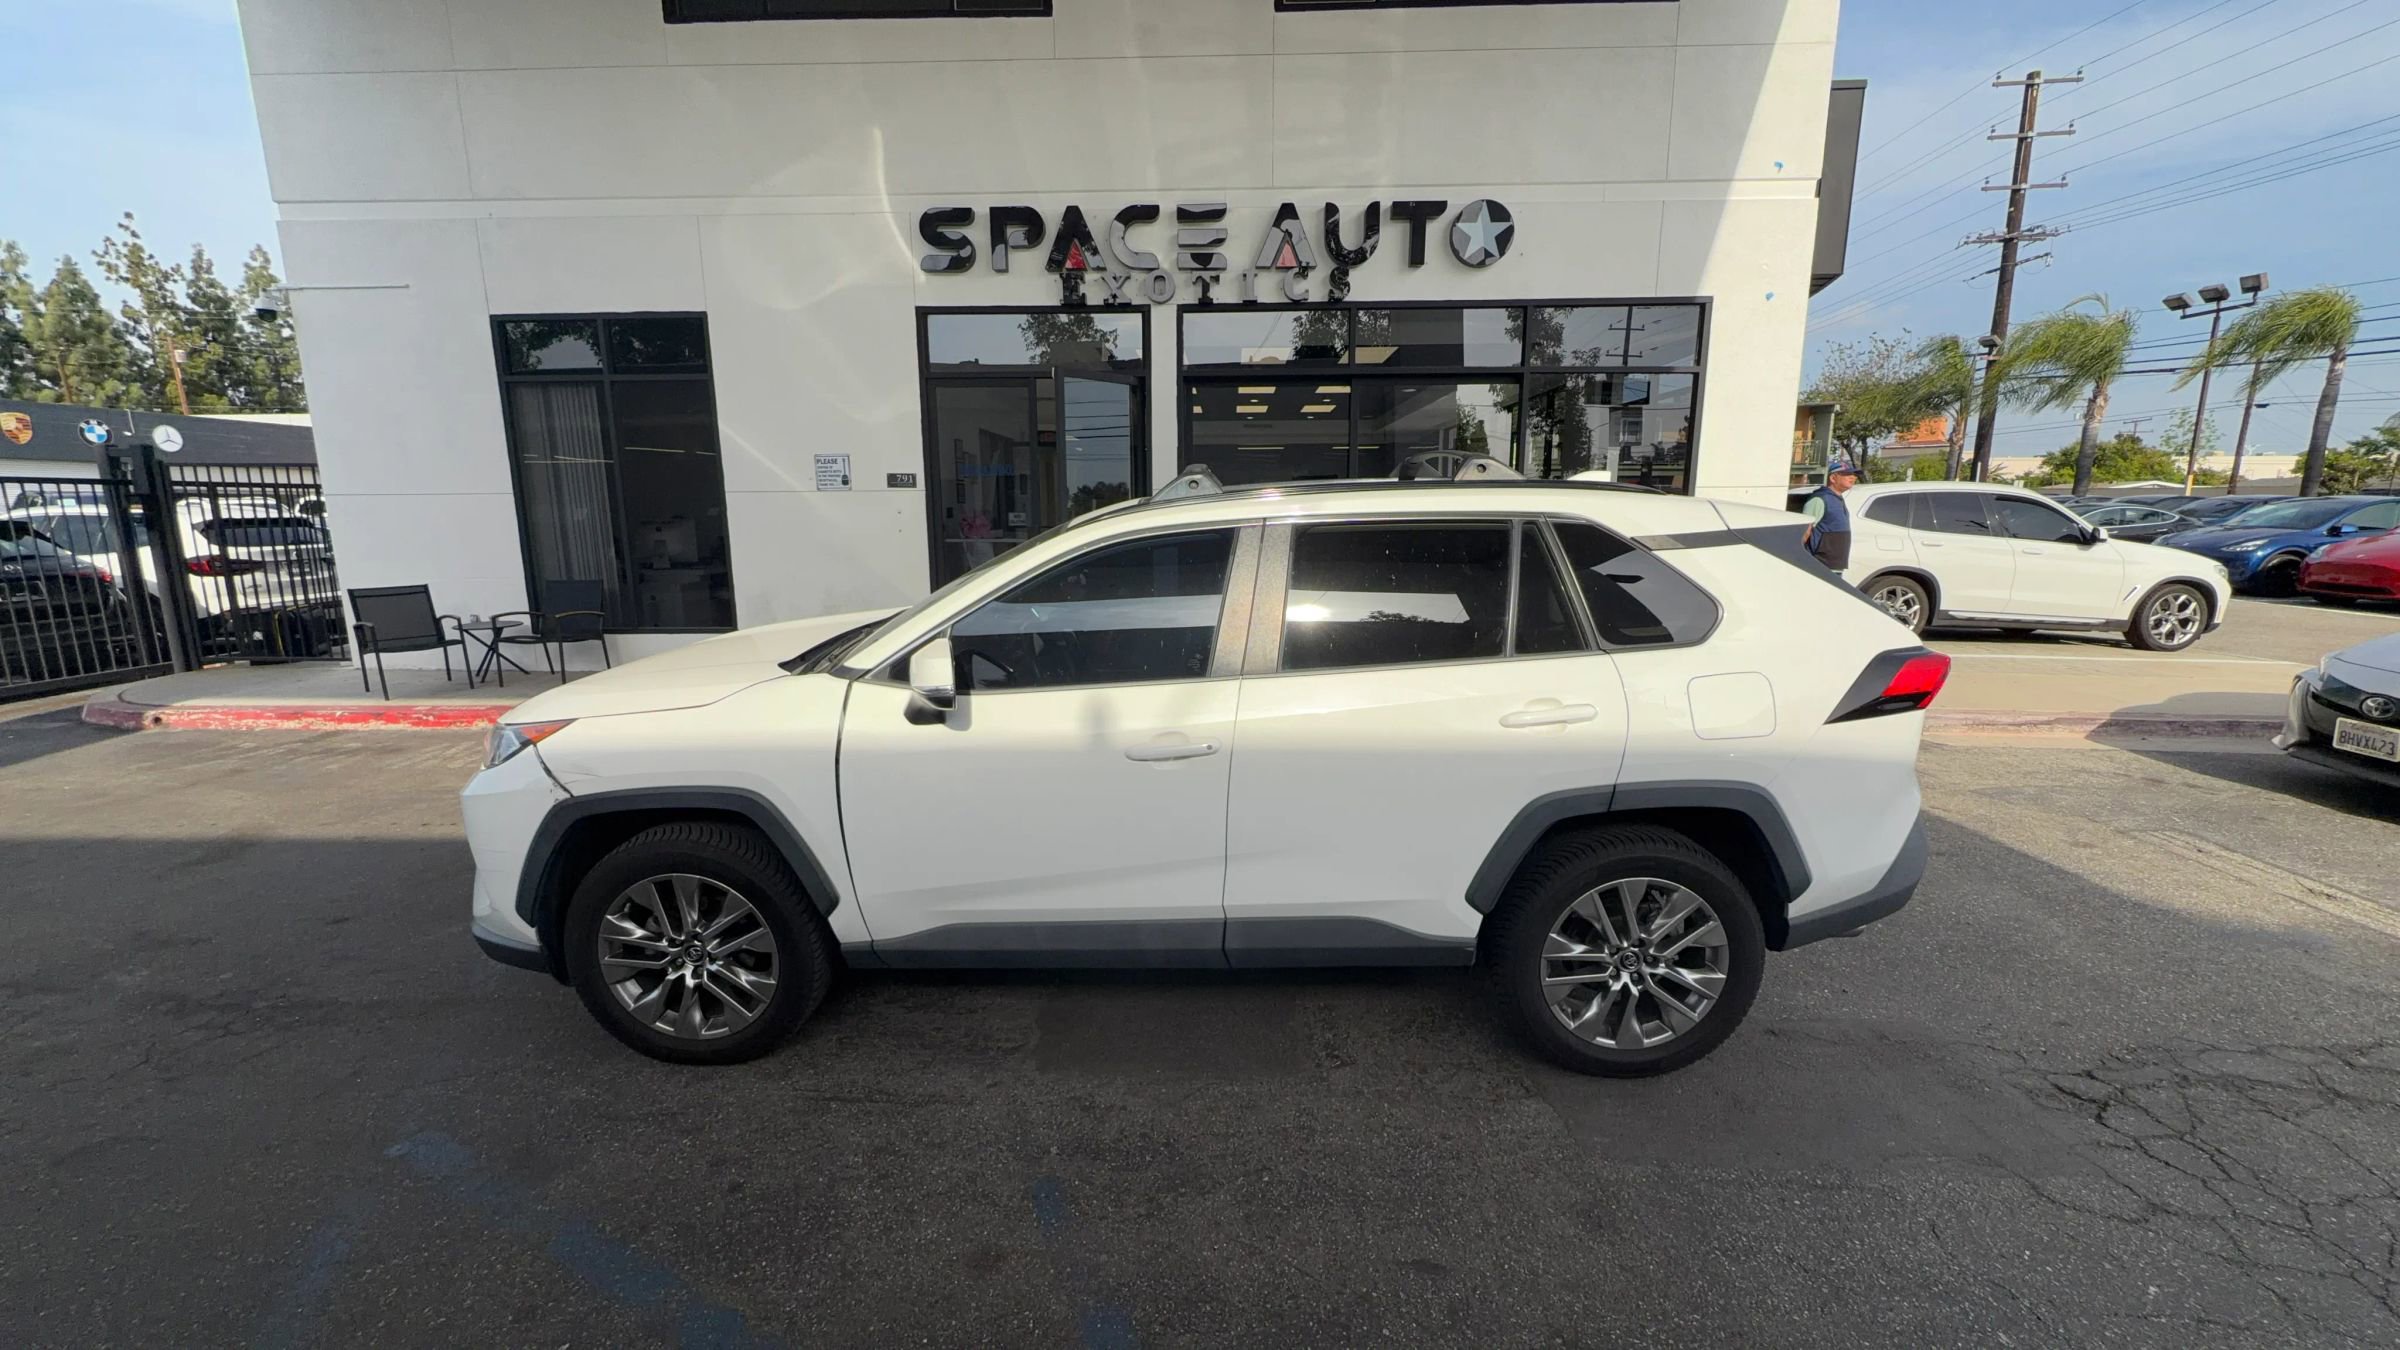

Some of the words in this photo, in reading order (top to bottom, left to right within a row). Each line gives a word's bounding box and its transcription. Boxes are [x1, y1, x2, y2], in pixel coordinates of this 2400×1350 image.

[919, 203, 1228, 273] SPACE
[1060, 266, 1351, 304] EXOTICS
[896, 474, 913, 483] 791
